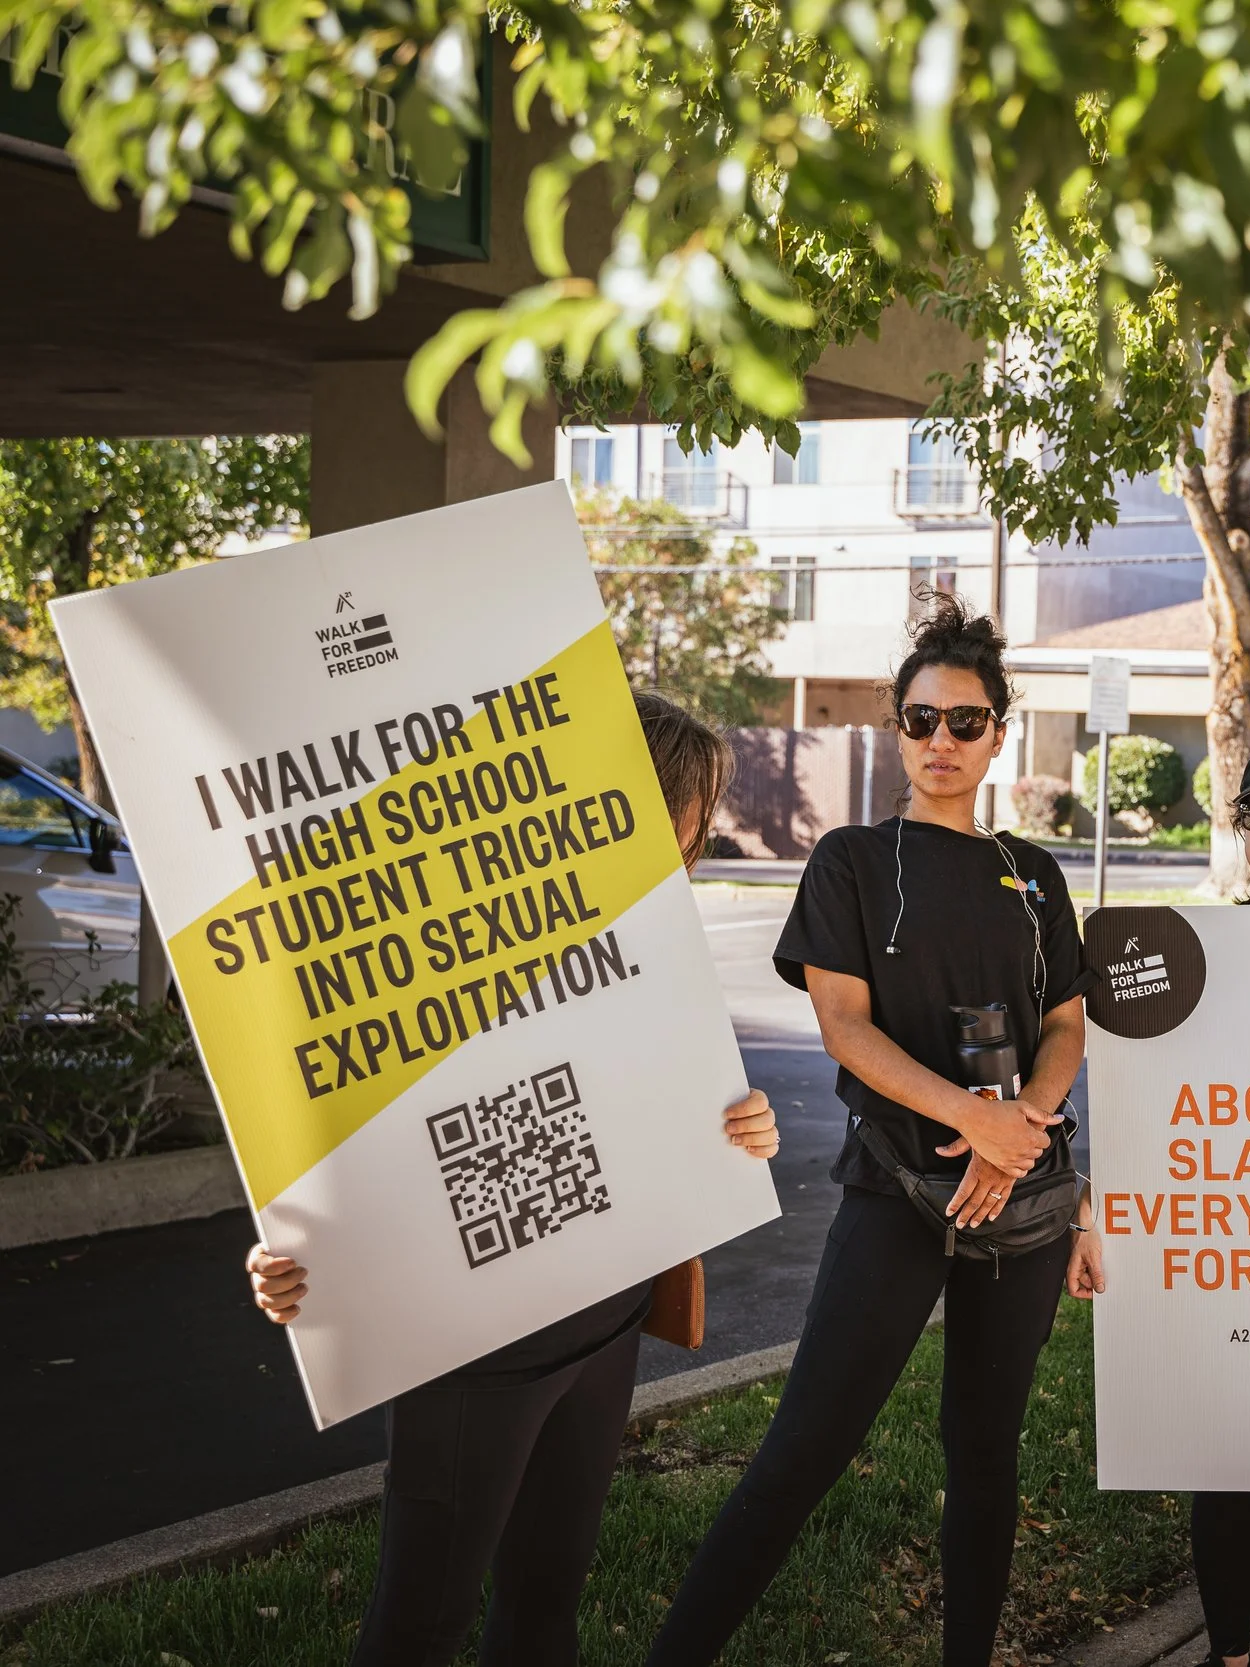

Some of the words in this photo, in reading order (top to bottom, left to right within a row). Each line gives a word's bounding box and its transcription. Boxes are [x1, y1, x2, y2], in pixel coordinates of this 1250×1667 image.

[315, 620, 361, 643] WALK
[321, 641, 353, 661] FOR
[327, 647, 399, 678] FREEDOM
[195, 774, 222, 831] I
[221, 729, 376, 820] WALK
[374, 703, 474, 776] FOR
[472, 672, 570, 743] THE
[245, 802, 376, 889] HIGH
[377, 745, 566, 846] SCHOOL
[205, 851, 433, 975] STUDENT
[440, 789, 636, 894] TRICKED
[294, 933, 415, 1020] INTO
[420, 871, 601, 973] SEXUAL
[1107, 959, 1143, 976] WALK
[1111, 975, 1136, 989] FOR
[1114, 980, 1171, 1002] FREEDOM
[294, 930, 641, 1100] EXPLOITATION.
